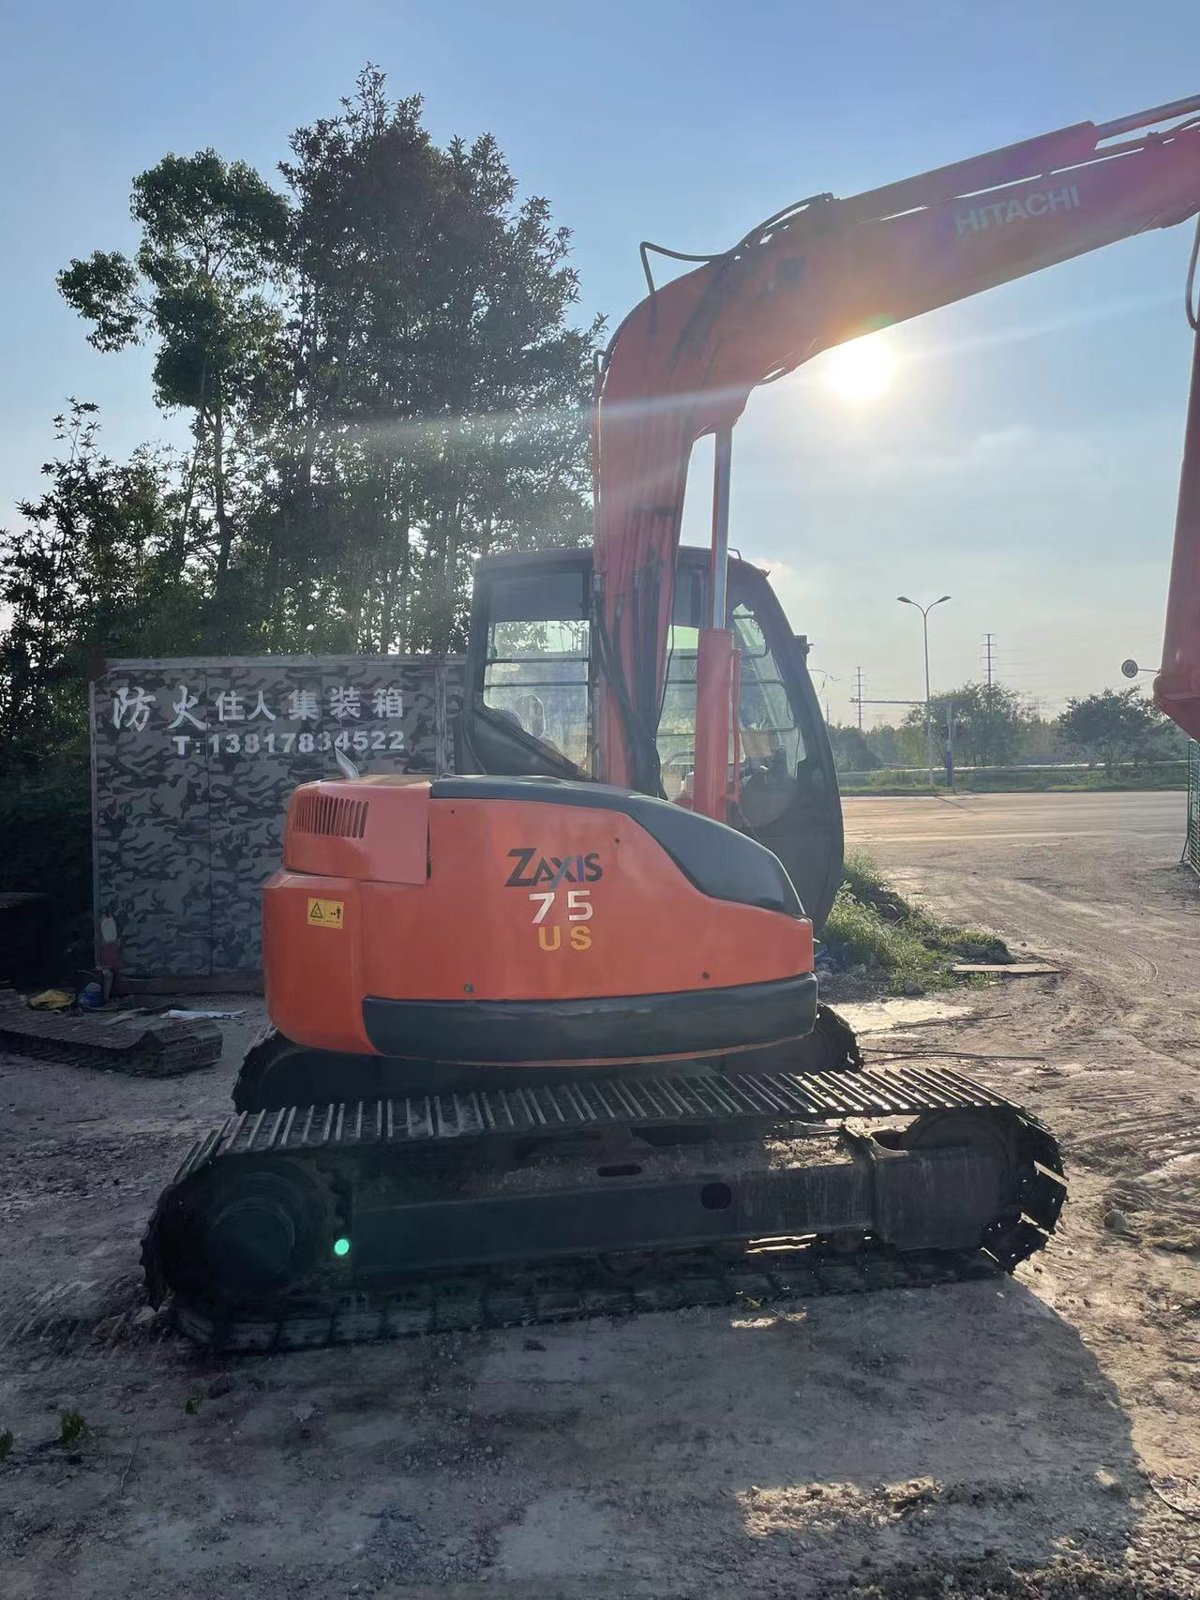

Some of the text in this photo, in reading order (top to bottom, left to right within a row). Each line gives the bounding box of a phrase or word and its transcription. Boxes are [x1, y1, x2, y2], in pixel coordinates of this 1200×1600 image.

[953, 185, 1081, 235] HITACHI
[112, 685, 403, 733] 防火住人集装箱
[504, 848, 603, 889] ZAXIS
[529, 890, 594, 924] 75
[538, 925, 592, 951] US
